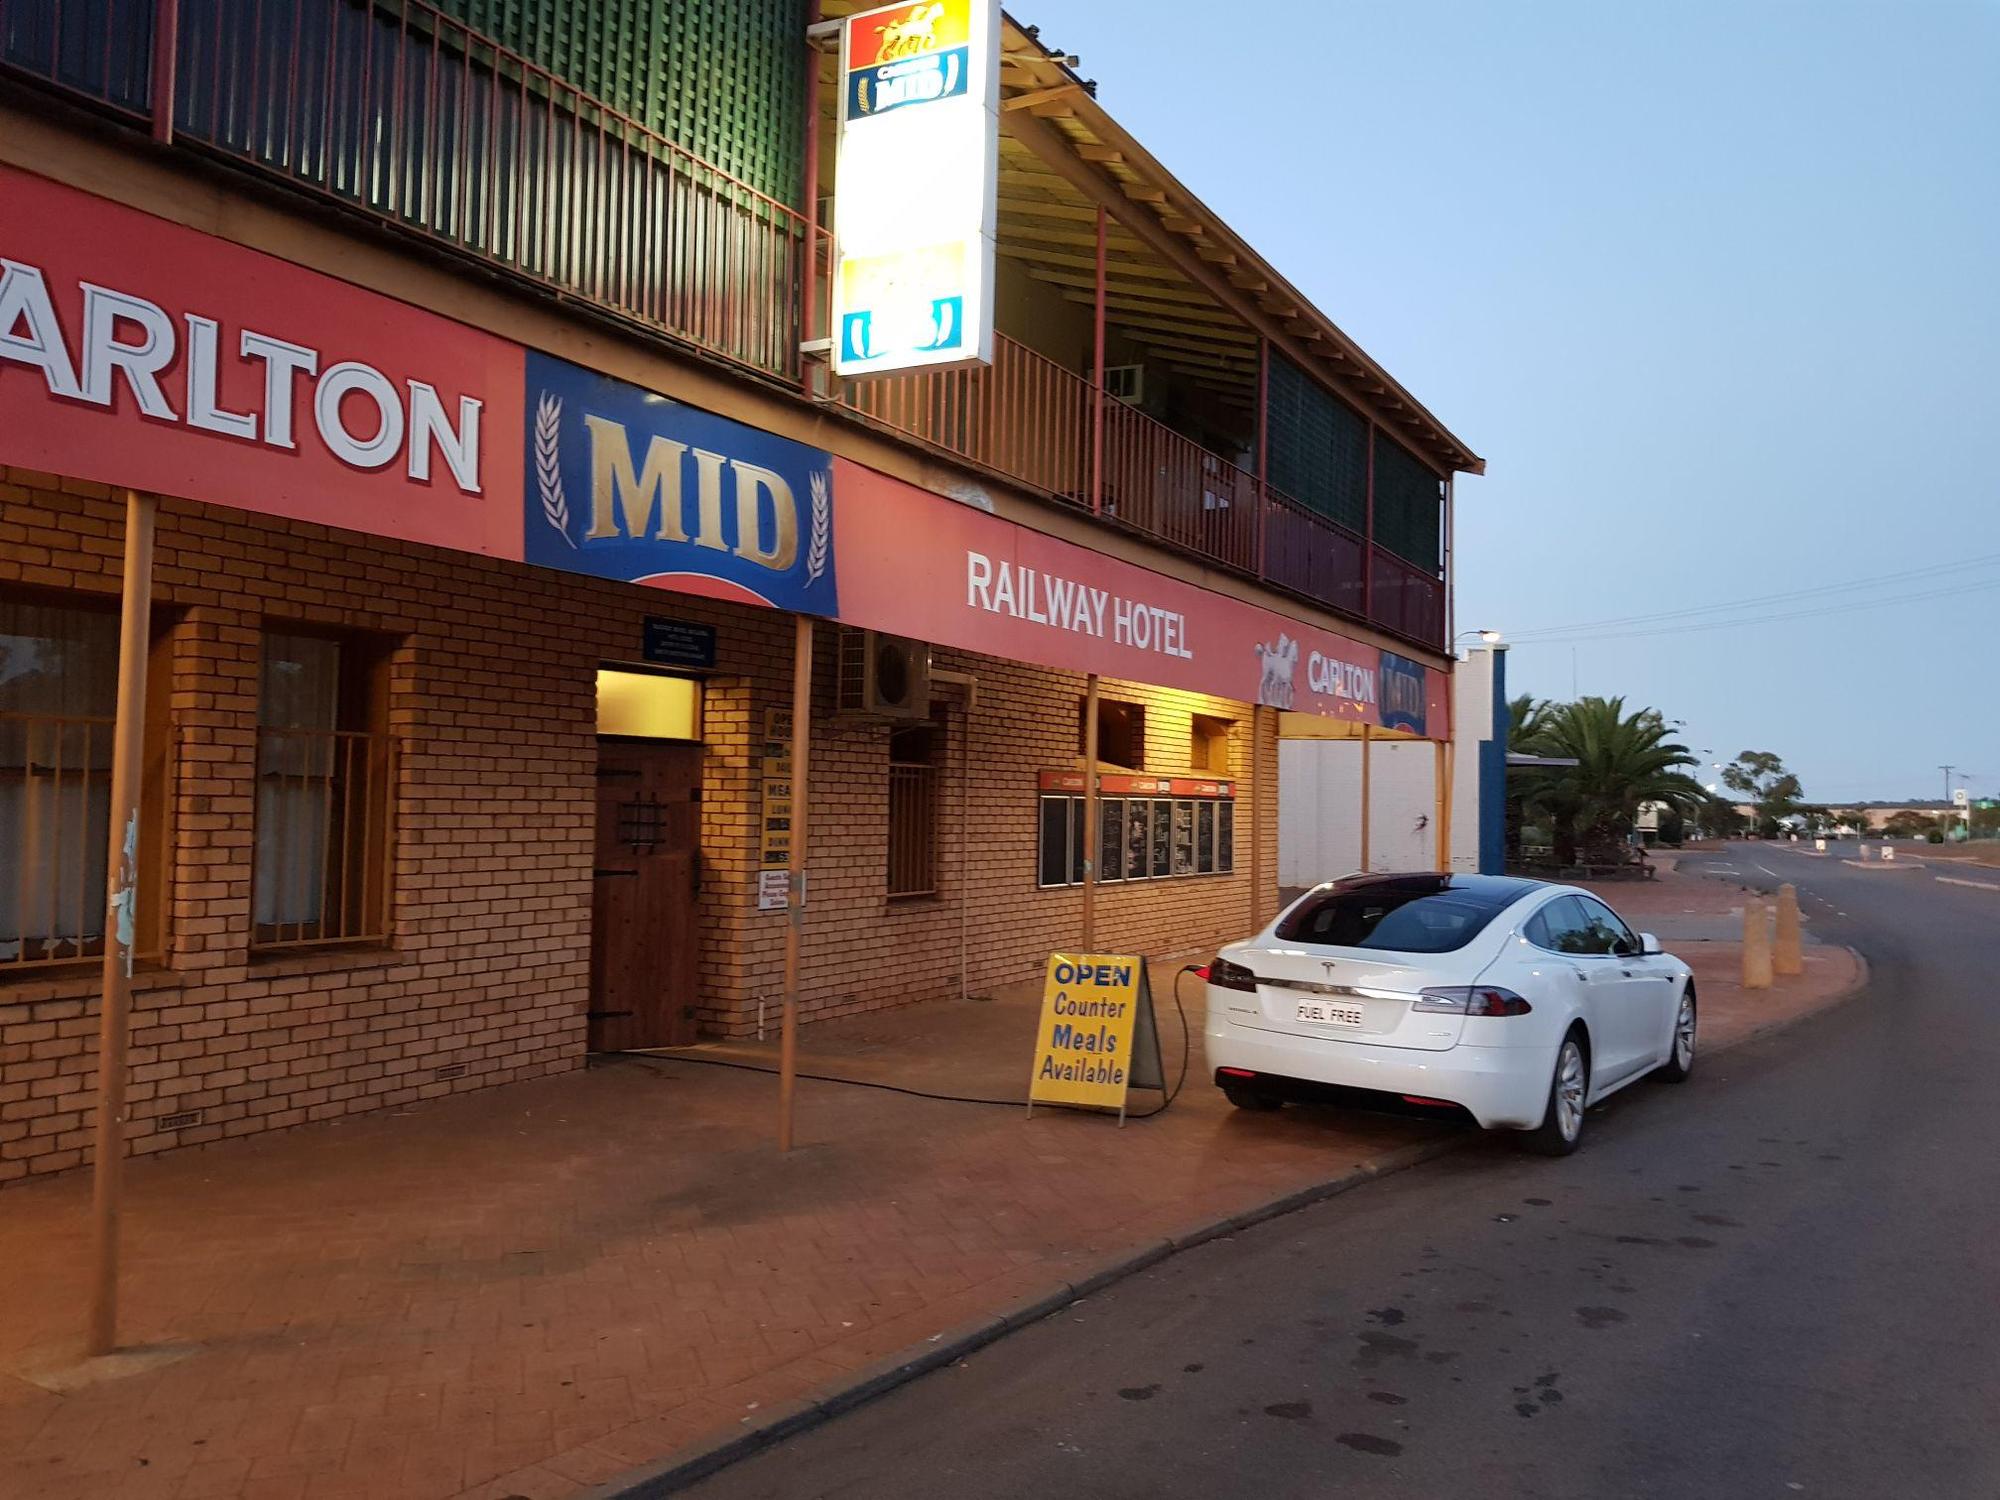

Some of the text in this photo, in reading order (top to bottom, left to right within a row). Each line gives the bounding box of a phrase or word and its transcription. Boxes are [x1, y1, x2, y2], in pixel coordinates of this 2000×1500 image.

[584, 414, 799, 571] MID
[967, 551, 1192, 659] RAILWAY HOTEL
[1308, 650, 1375, 704] CARLTON
[768, 784, 792, 797] MEA
[1055, 963, 1131, 986] OPEN
[1054, 991, 1126, 1018] Counter
[1297, 1005, 1361, 1024] FUEL FREE
[1052, 1023, 1117, 1052] Meals
[1040, 1055, 1123, 1084] Available
